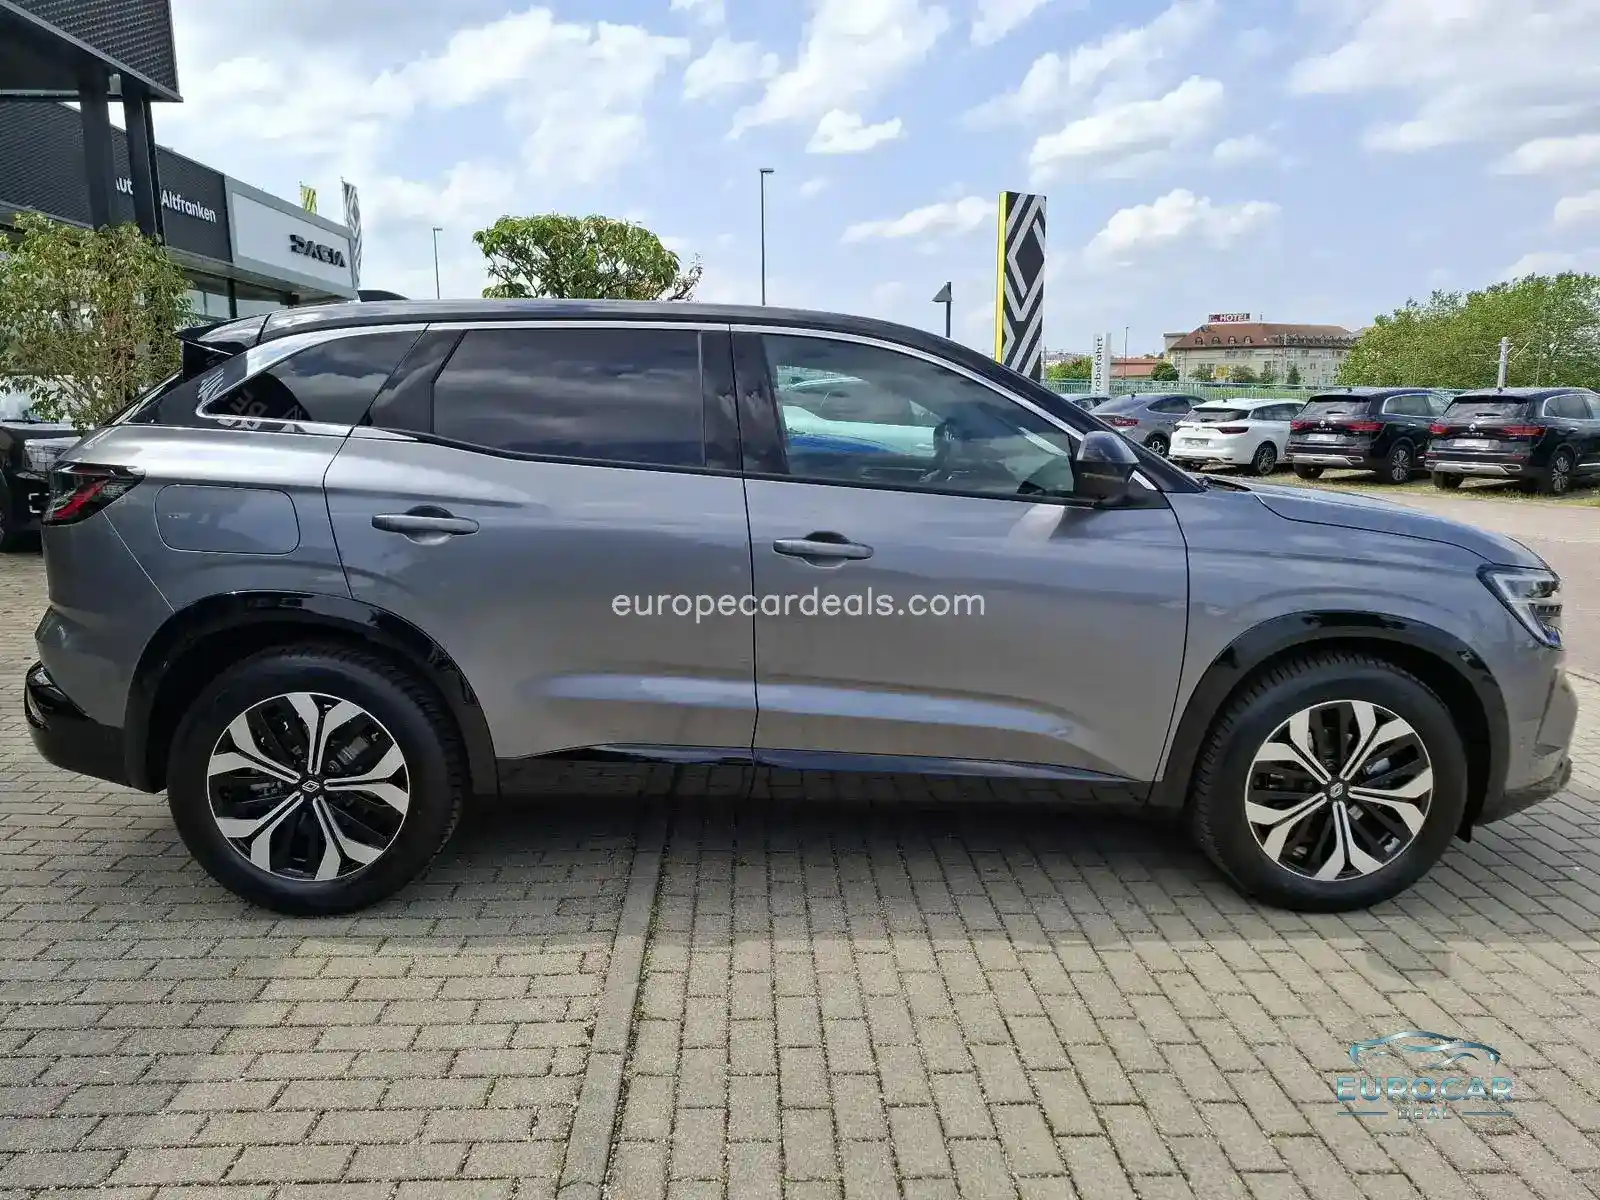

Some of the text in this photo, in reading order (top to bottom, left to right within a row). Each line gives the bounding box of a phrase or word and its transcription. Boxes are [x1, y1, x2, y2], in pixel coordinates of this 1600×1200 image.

[161, 190, 217, 223] Altfranken
[289, 234, 347, 268] DACIA
[1219, 313, 1251, 323] HOTEL
